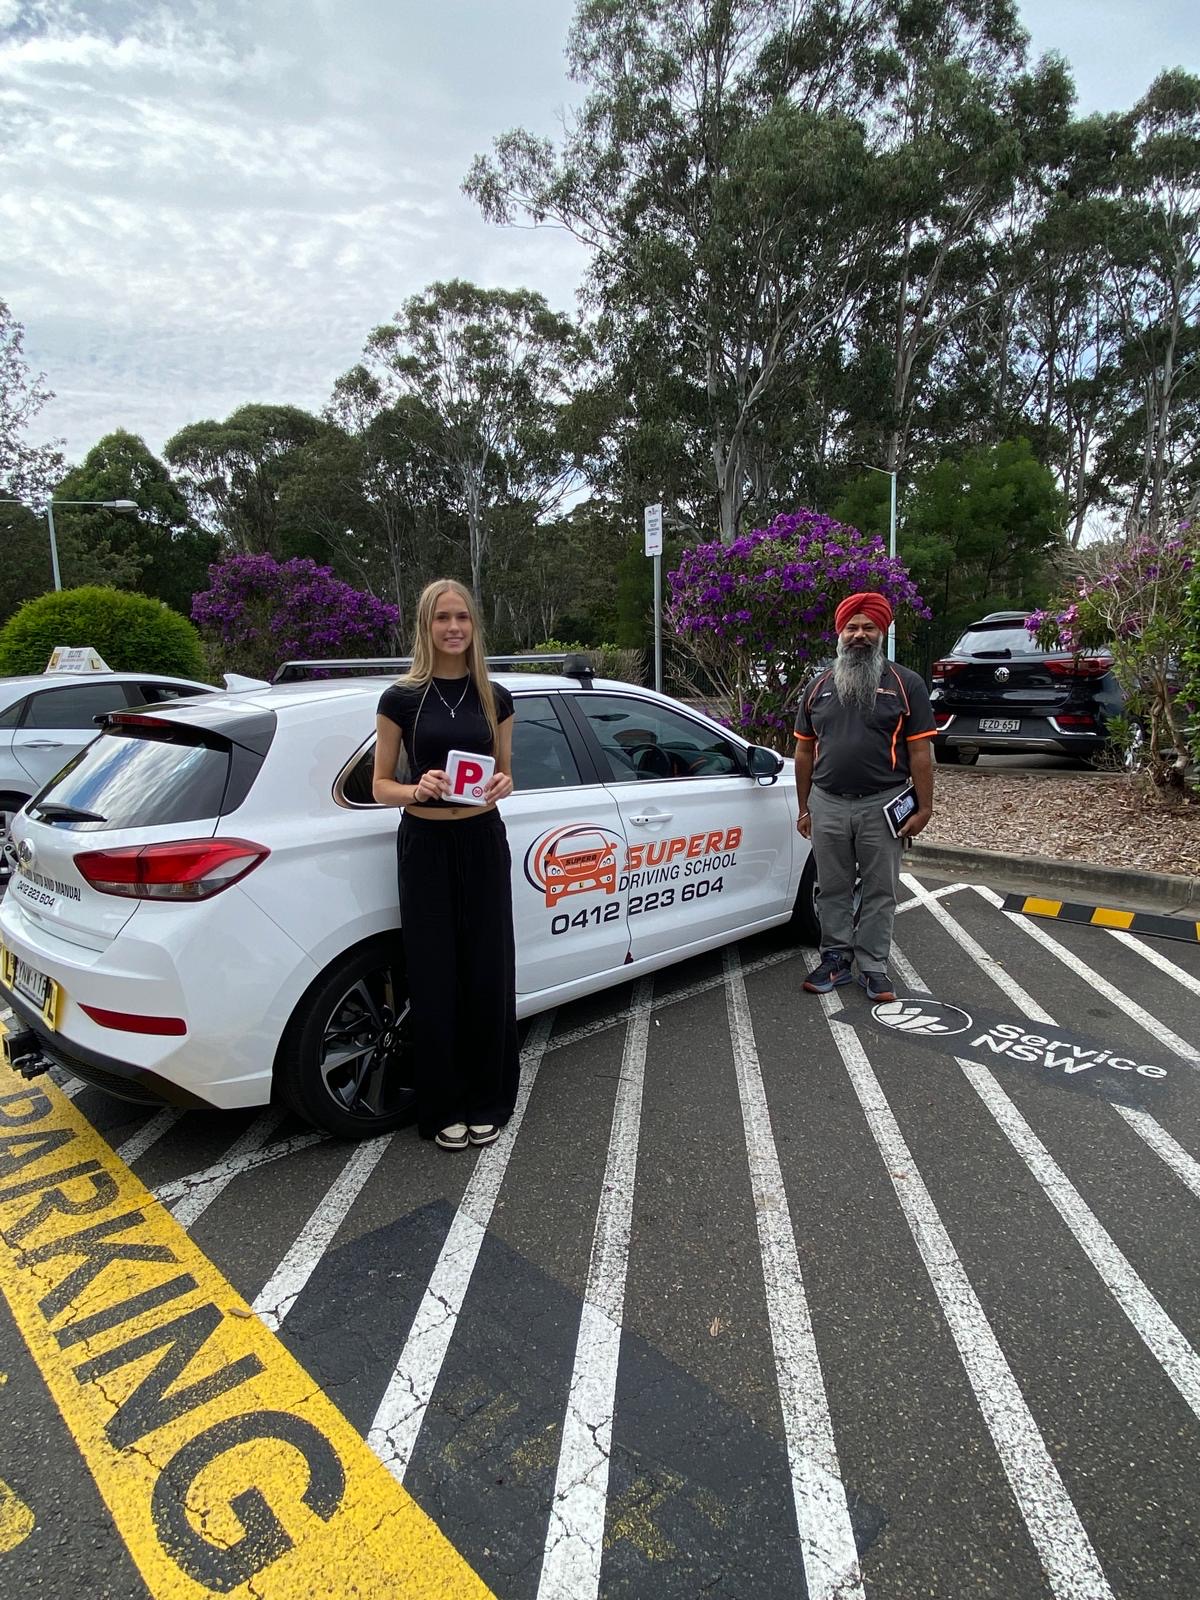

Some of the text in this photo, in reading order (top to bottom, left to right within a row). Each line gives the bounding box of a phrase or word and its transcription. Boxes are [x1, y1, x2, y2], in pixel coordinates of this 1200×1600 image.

[91, 659, 100, 670] L
[454, 760, 483, 795] P
[565, 854, 597, 866] SUPERB
[618, 842, 737, 892] DRIVING SCHOOL
[622, 826, 743, 872] SUPERB
[27, 887, 40, 901] 223
[39, 893, 56, 907] 604
[55, 880, 81, 902] MANUAL
[551, 876, 723, 936] 0412 223 604
[968, 1034, 1097, 1075] NSW
[988, 1023, 1168, 1079] Service
[0, 1086, 346, 1593] PARKING
